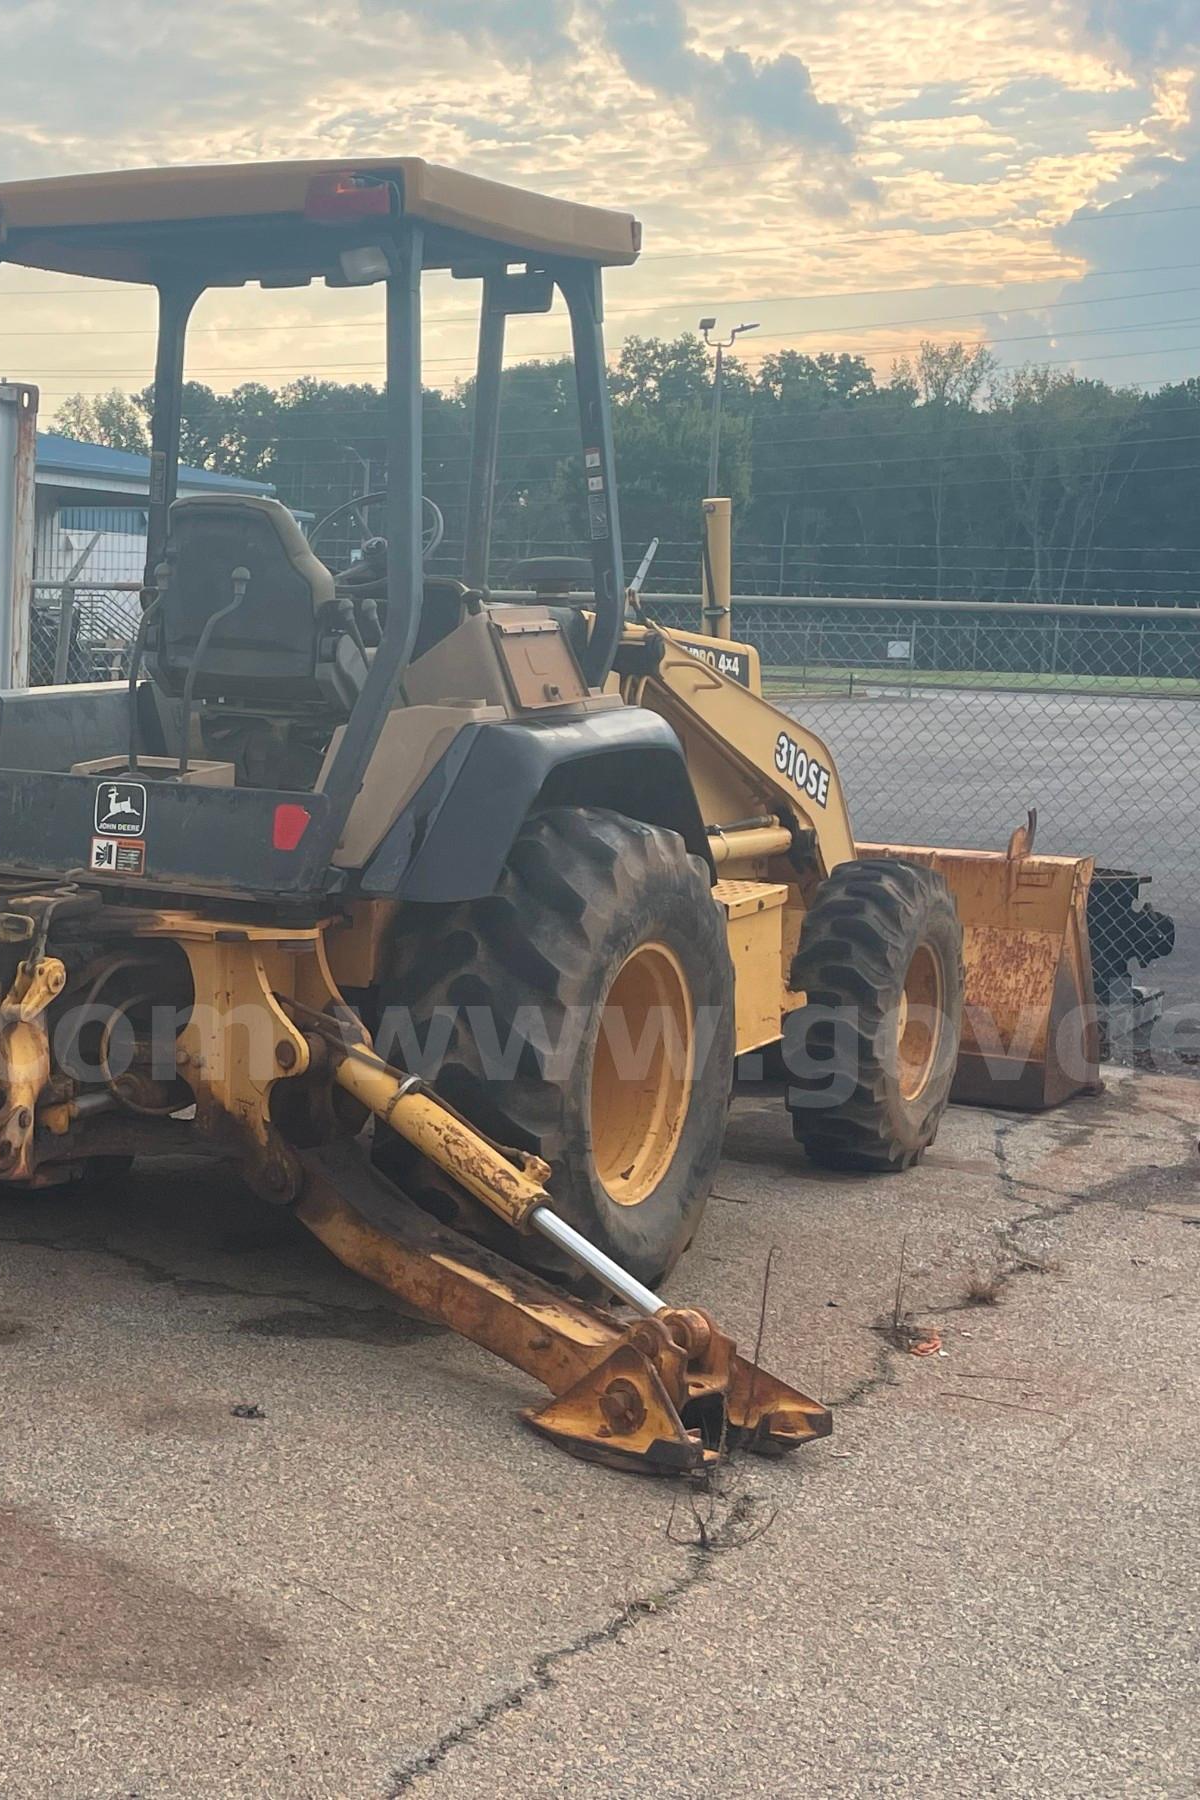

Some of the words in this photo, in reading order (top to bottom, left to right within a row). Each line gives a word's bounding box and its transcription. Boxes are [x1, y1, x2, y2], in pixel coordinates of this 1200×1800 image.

[718, 653, 740, 677] 4x4
[775, 734, 830, 805] 310SE
[99, 822, 117, 831] JOHN
[117, 823, 141, 832] DEERE
